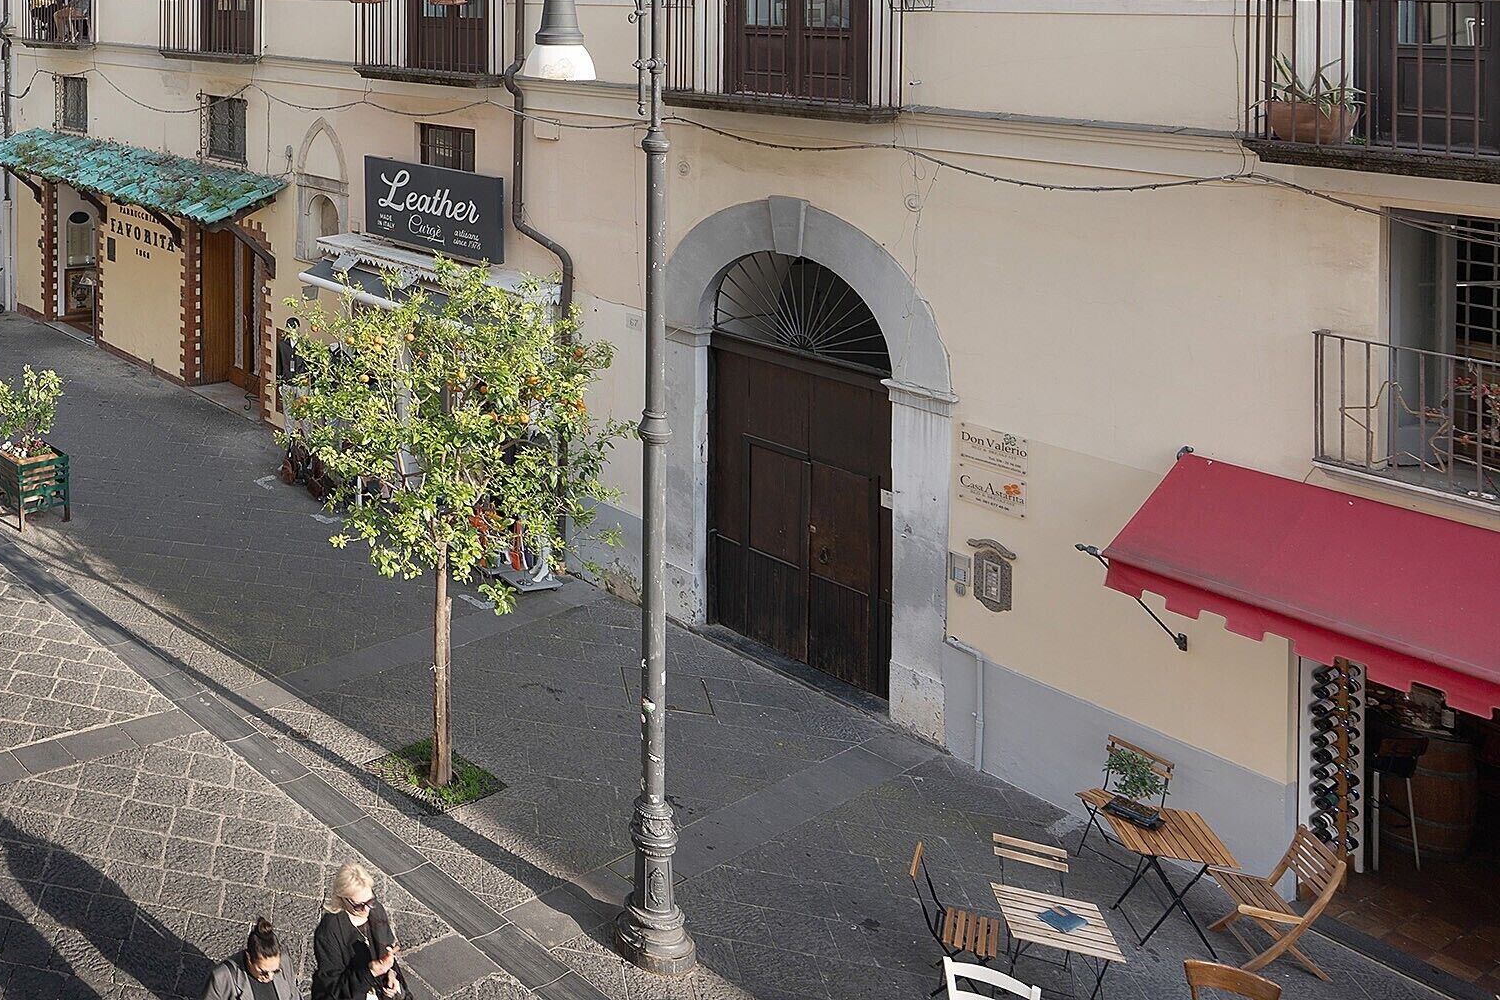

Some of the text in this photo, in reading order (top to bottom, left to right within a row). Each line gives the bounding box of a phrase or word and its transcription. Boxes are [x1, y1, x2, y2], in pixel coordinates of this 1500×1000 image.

[378, 169, 480, 225] Leather
[110, 218, 175, 253] FAVORITA
[961, 431, 984, 446] Don
[986, 438, 1027, 457] Valerio
[960, 474, 984, 492] Casa
[984, 482, 1025, 504] Astarita
